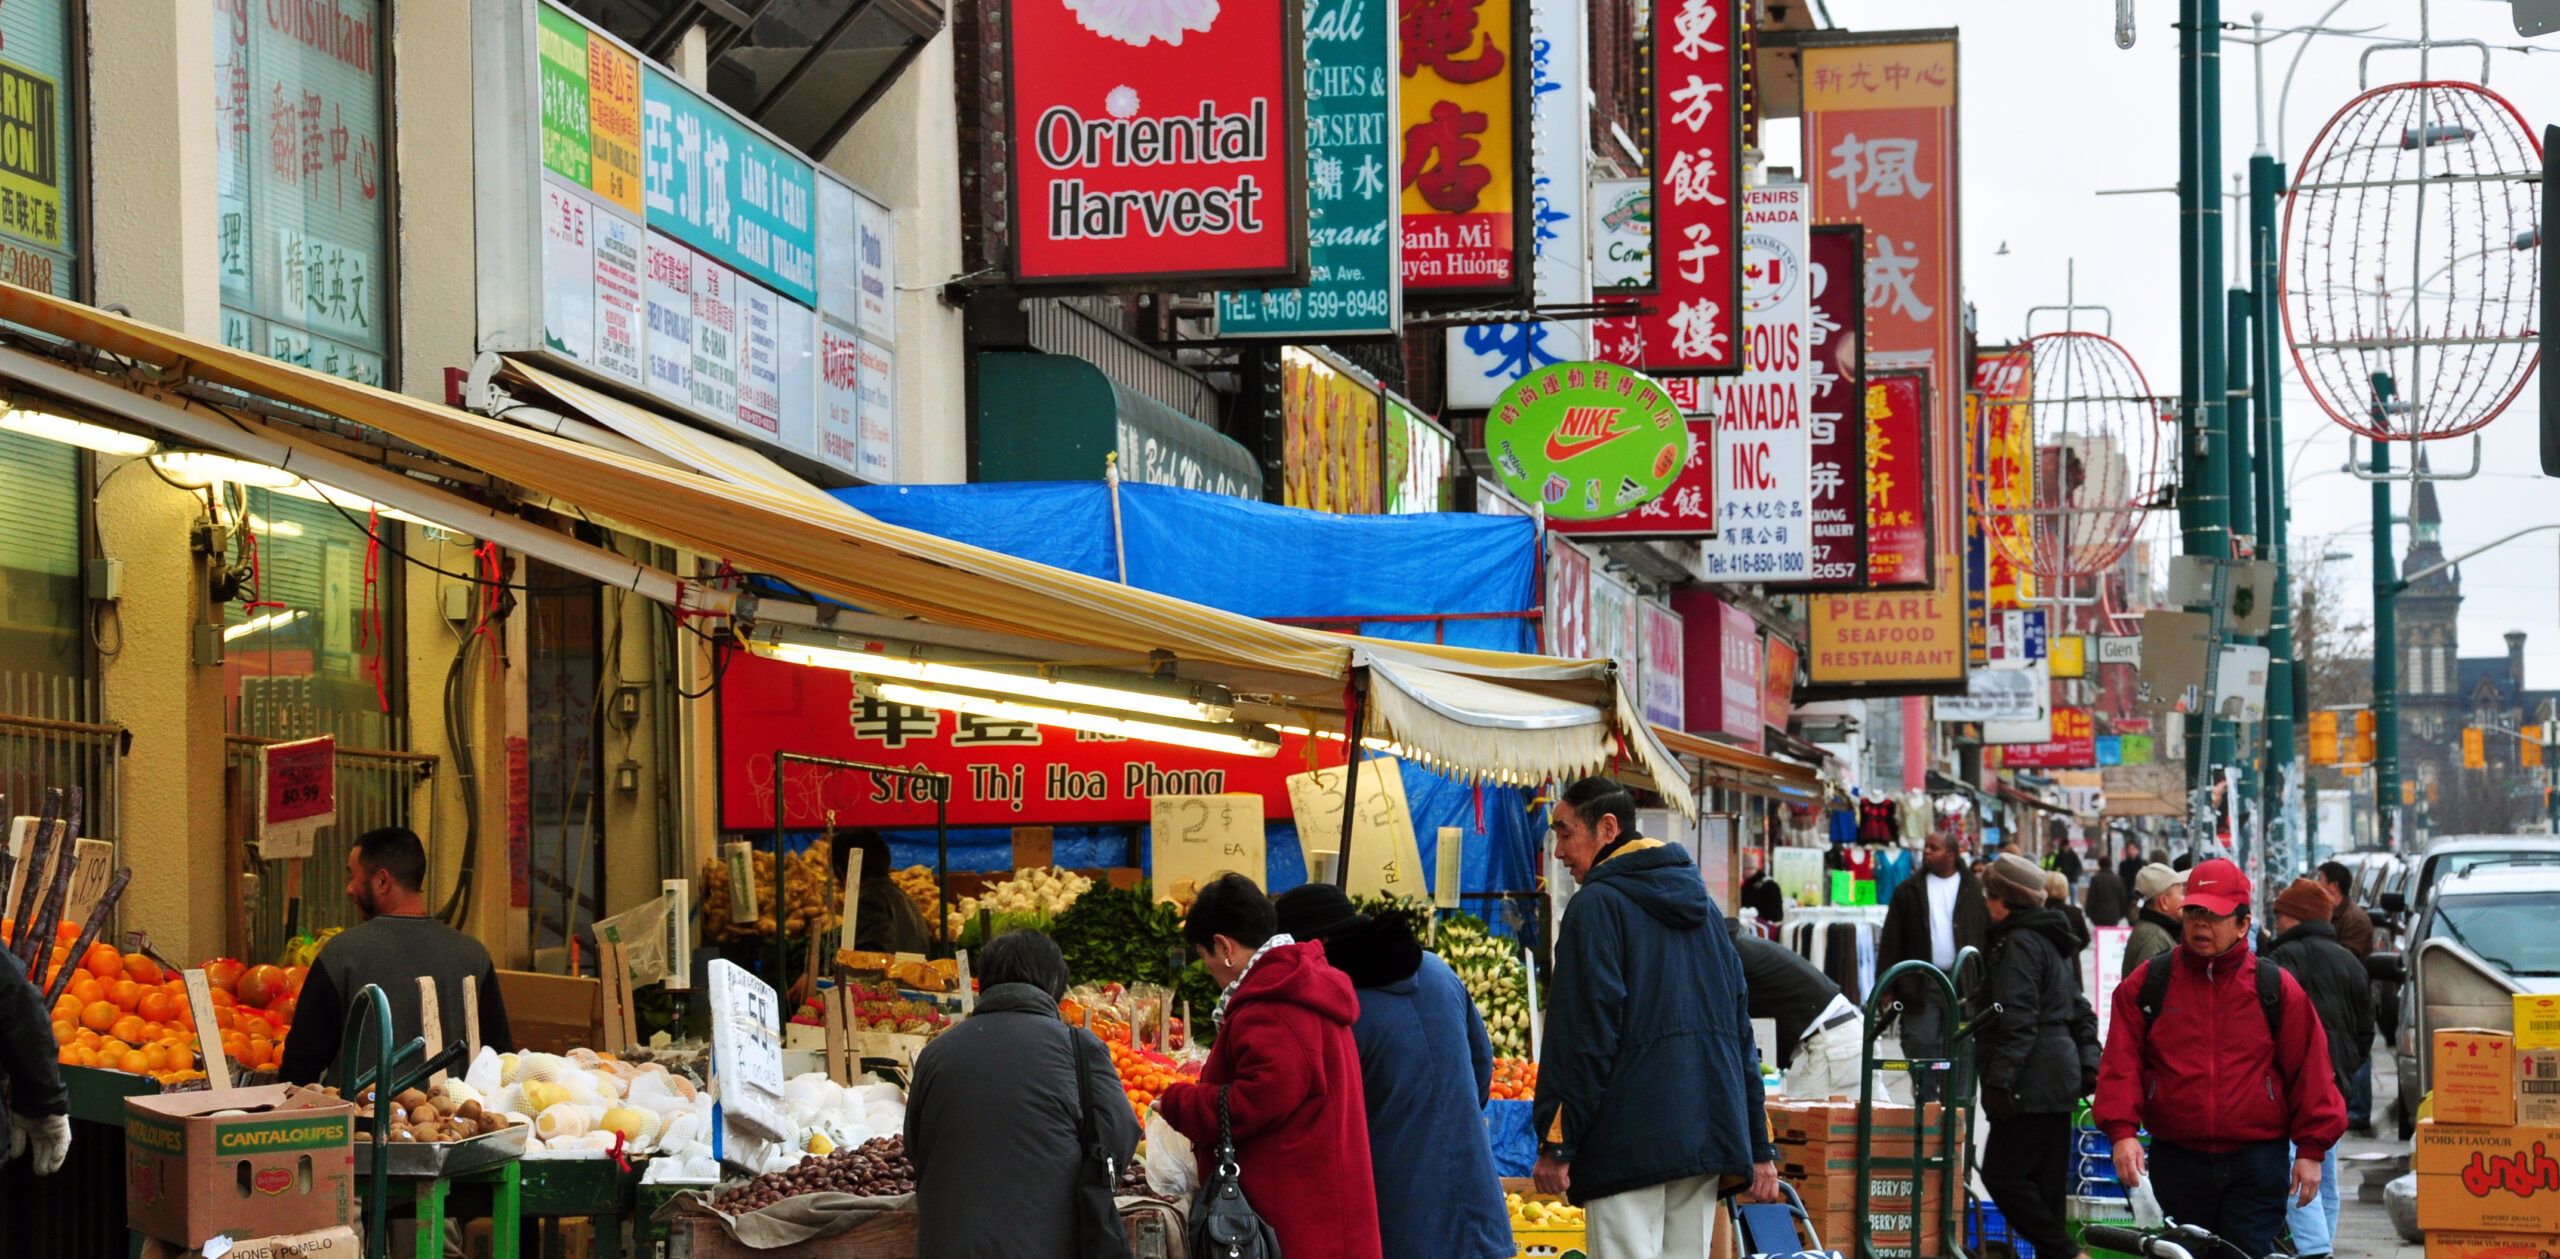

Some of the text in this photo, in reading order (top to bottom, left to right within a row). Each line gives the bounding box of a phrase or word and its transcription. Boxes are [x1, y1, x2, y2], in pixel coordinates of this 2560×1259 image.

[1306, 65, 1386, 98] CHES &
[1812, 61, 1948, 94] 新光中心
[0, 70, 33, 126] RN
[214, 50, 249, 166] 律
[1037, 98, 1266, 169] Oriental
[0, 121, 34, 175] ON
[1663, 0, 1729, 361] 東方餃子樓
[1050, 175, 1262, 239] Harvest
[1742, 190, 1799, 205] VENIRS
[1744, 210, 1799, 224] ANADA
[1309, 219, 1388, 248] urant
[1456, 218, 1492, 248] Mì
[737, 213, 814, 293] ASIAN VILLAGE
[1336, 265, 1366, 281] Ave.
[1401, 251, 1442, 281] uyên
[286, 230, 368, 328] 精通英文
[1221, 290, 1389, 322] TEL: (416) 599-8948
[1499, 367, 1675, 431] 時尚運動鞋專門店
[1558, 406, 1625, 437] NIKE
[1732, 441, 1776, 491] INC.
[1718, 500, 1803, 520] 拿大紀念品
[1724, 525, 1788, 546] 有限公司
[1814, 523, 1855, 537] BAKERY
[1707, 551, 1804, 574] Tel: 416-850-1800
[1812, 544, 1831, 560] 47
[1813, 562, 1856, 579] 2657
[1829, 598, 1943, 622] PEARL
[1837, 627, 1935, 644] SEAFOOD
[1820, 650, 1955, 667] RESTAURANT
[2104, 643, 2133, 657] Glen
[869, 762, 952, 804] Siêu
[966, 763, 1025, 813] Thị
[1046, 762, 1108, 801] Hoa
[1124, 760, 1226, 799] Phong
[1181, 798, 1209, 843] 2
[1224, 842, 1245, 856] EA
[221, 1125, 344, 1148] CANTALOUPES
[2423, 1135, 2512, 1147] PORK FLAVOUR
[1871, 1180, 1899, 1197] BERRY
[1869, 1214, 1898, 1231] BERRY
[232, 1238, 333, 1259] HONEY POMELO
[2502, 1240, 2537, 1248] FLAVOUR
